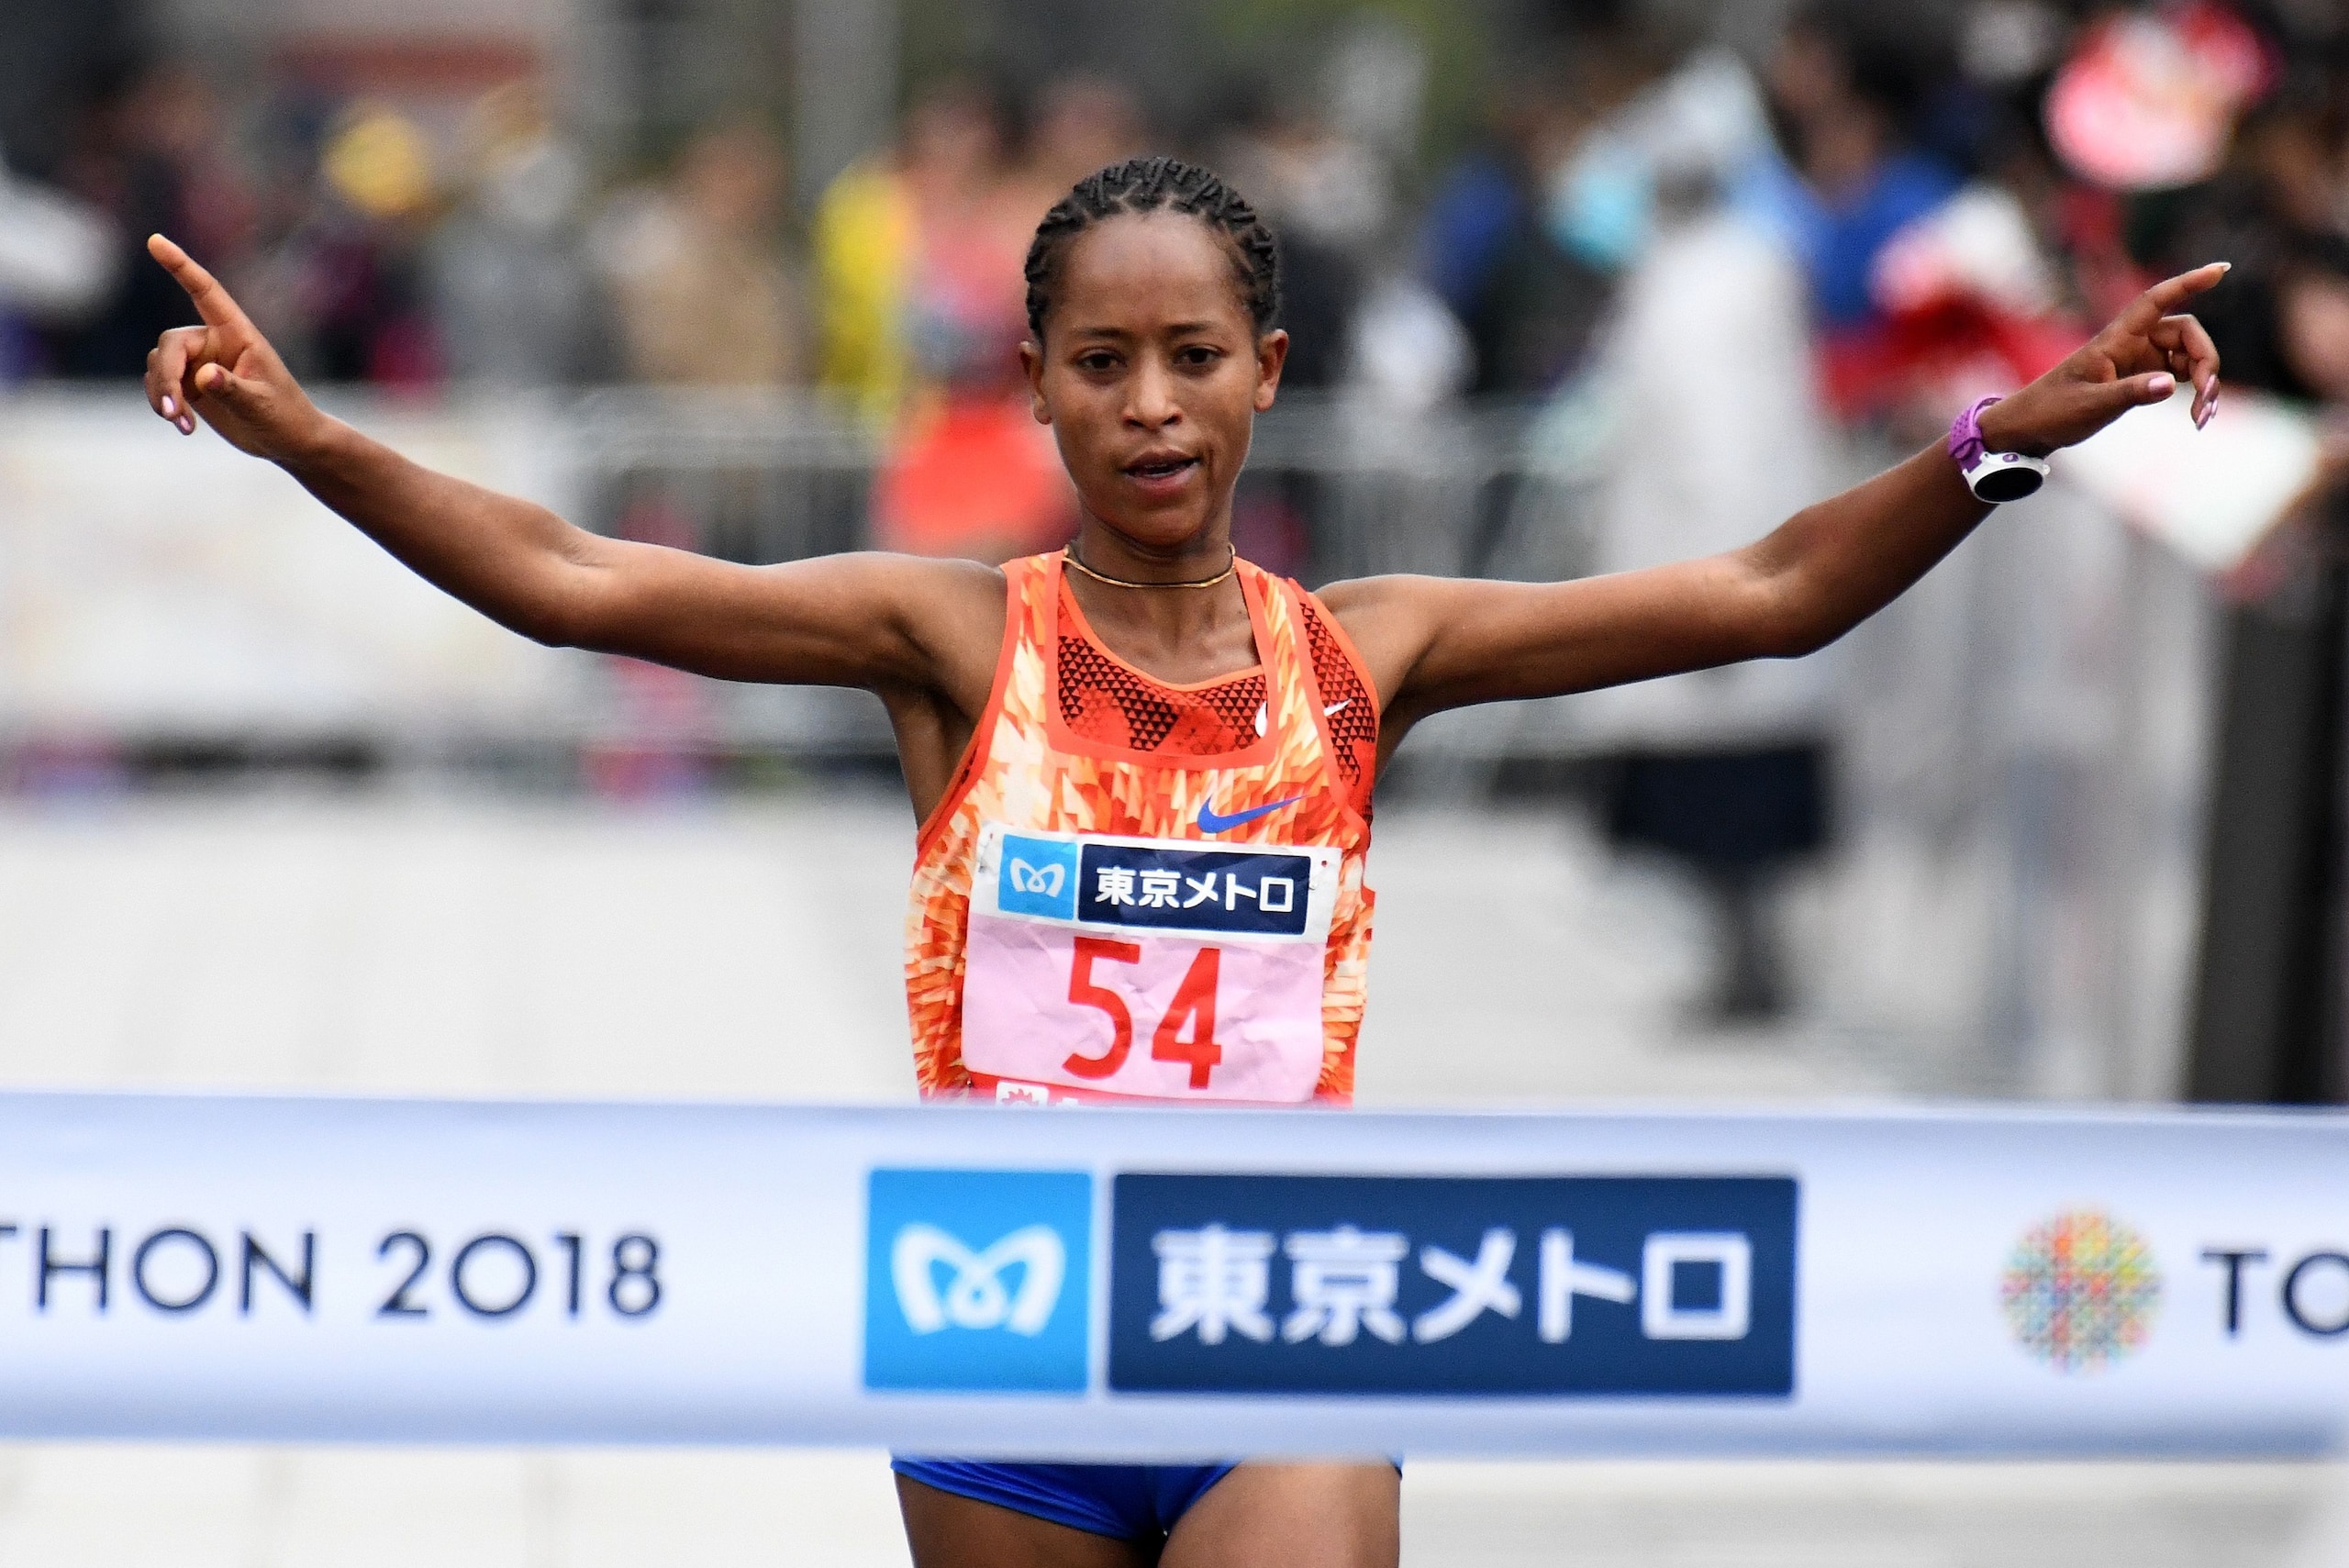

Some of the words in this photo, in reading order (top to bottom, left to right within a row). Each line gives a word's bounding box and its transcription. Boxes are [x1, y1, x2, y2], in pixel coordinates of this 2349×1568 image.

[1095, 865, 1294, 913] 東京メトロ
[1062, 936, 1222, 1090] 54
[0, 1224, 315, 1314] HON
[379, 1229, 662, 1319] 2018
[1151, 1224, 1752, 1345] 東京メトロ
[2202, 1250, 2349, 1340] TO
